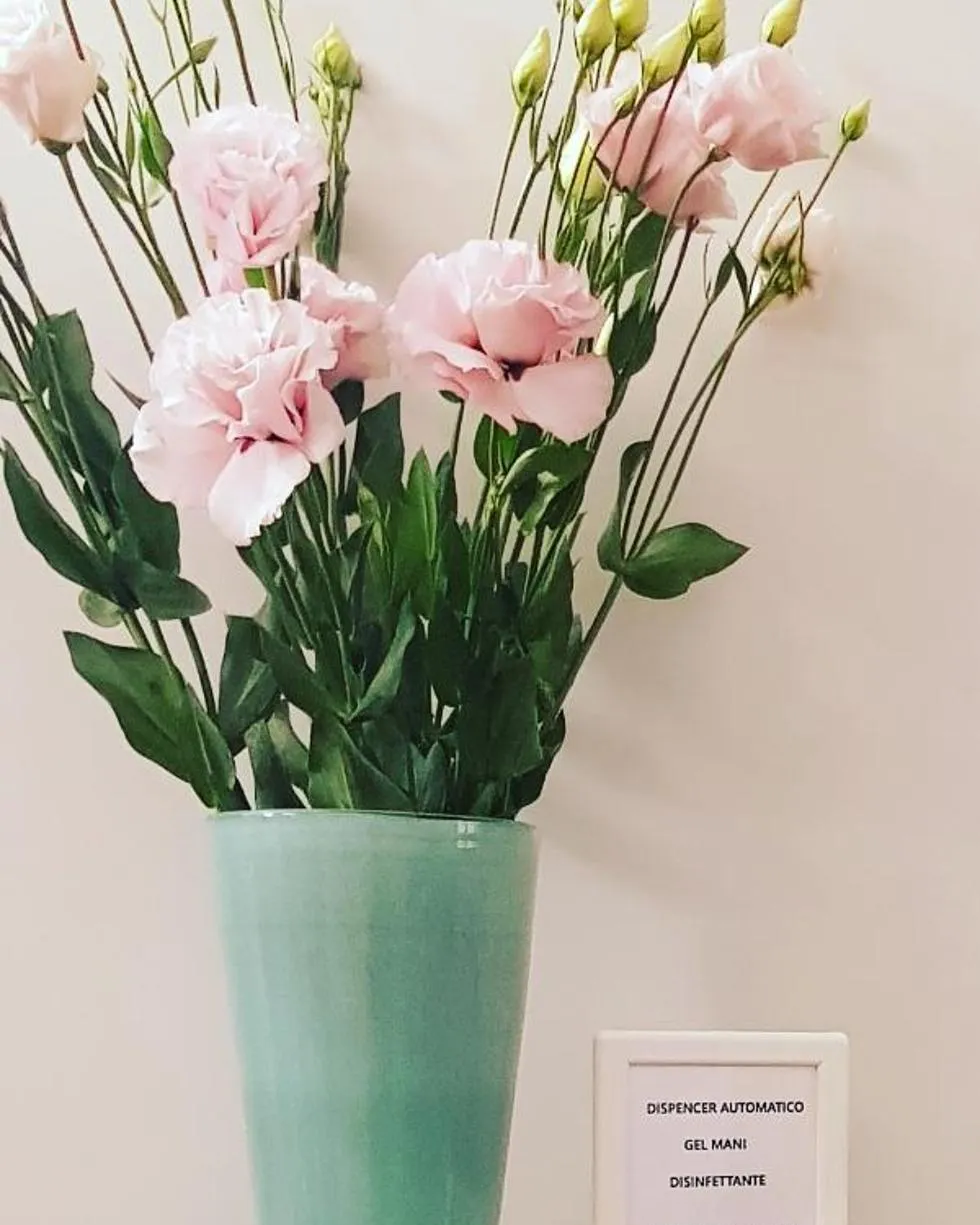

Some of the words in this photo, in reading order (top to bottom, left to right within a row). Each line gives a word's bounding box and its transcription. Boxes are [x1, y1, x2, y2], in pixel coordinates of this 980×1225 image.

[646, 1101, 718, 1115] DISPENCER
[719, 1100, 805, 1114] AUTOMATICO
[683, 1139, 709, 1151] GEL
[711, 1138, 747, 1151] MANI
[669, 1174, 766, 1189] DISINFETTANTE
